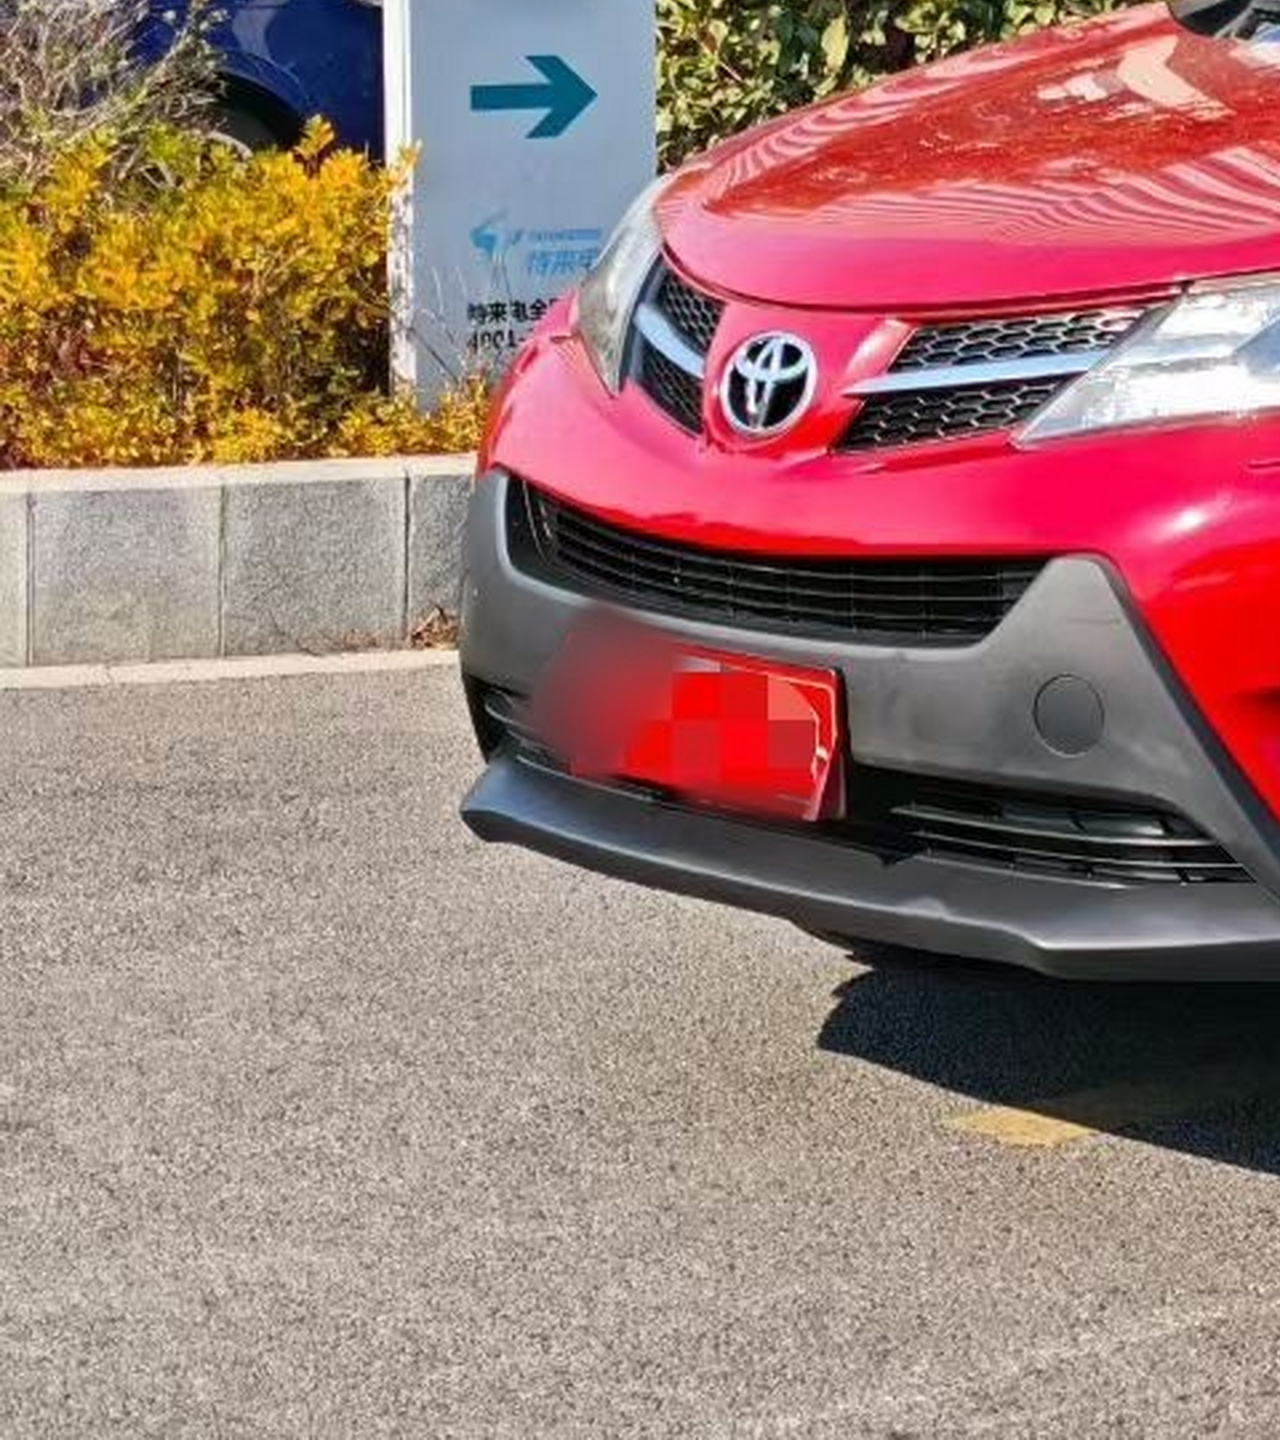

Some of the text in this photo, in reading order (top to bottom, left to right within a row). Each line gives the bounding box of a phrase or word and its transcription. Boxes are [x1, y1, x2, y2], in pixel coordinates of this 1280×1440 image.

[467, 298, 559, 324] 特来电全
[468, 328, 536, 351] 4001-
